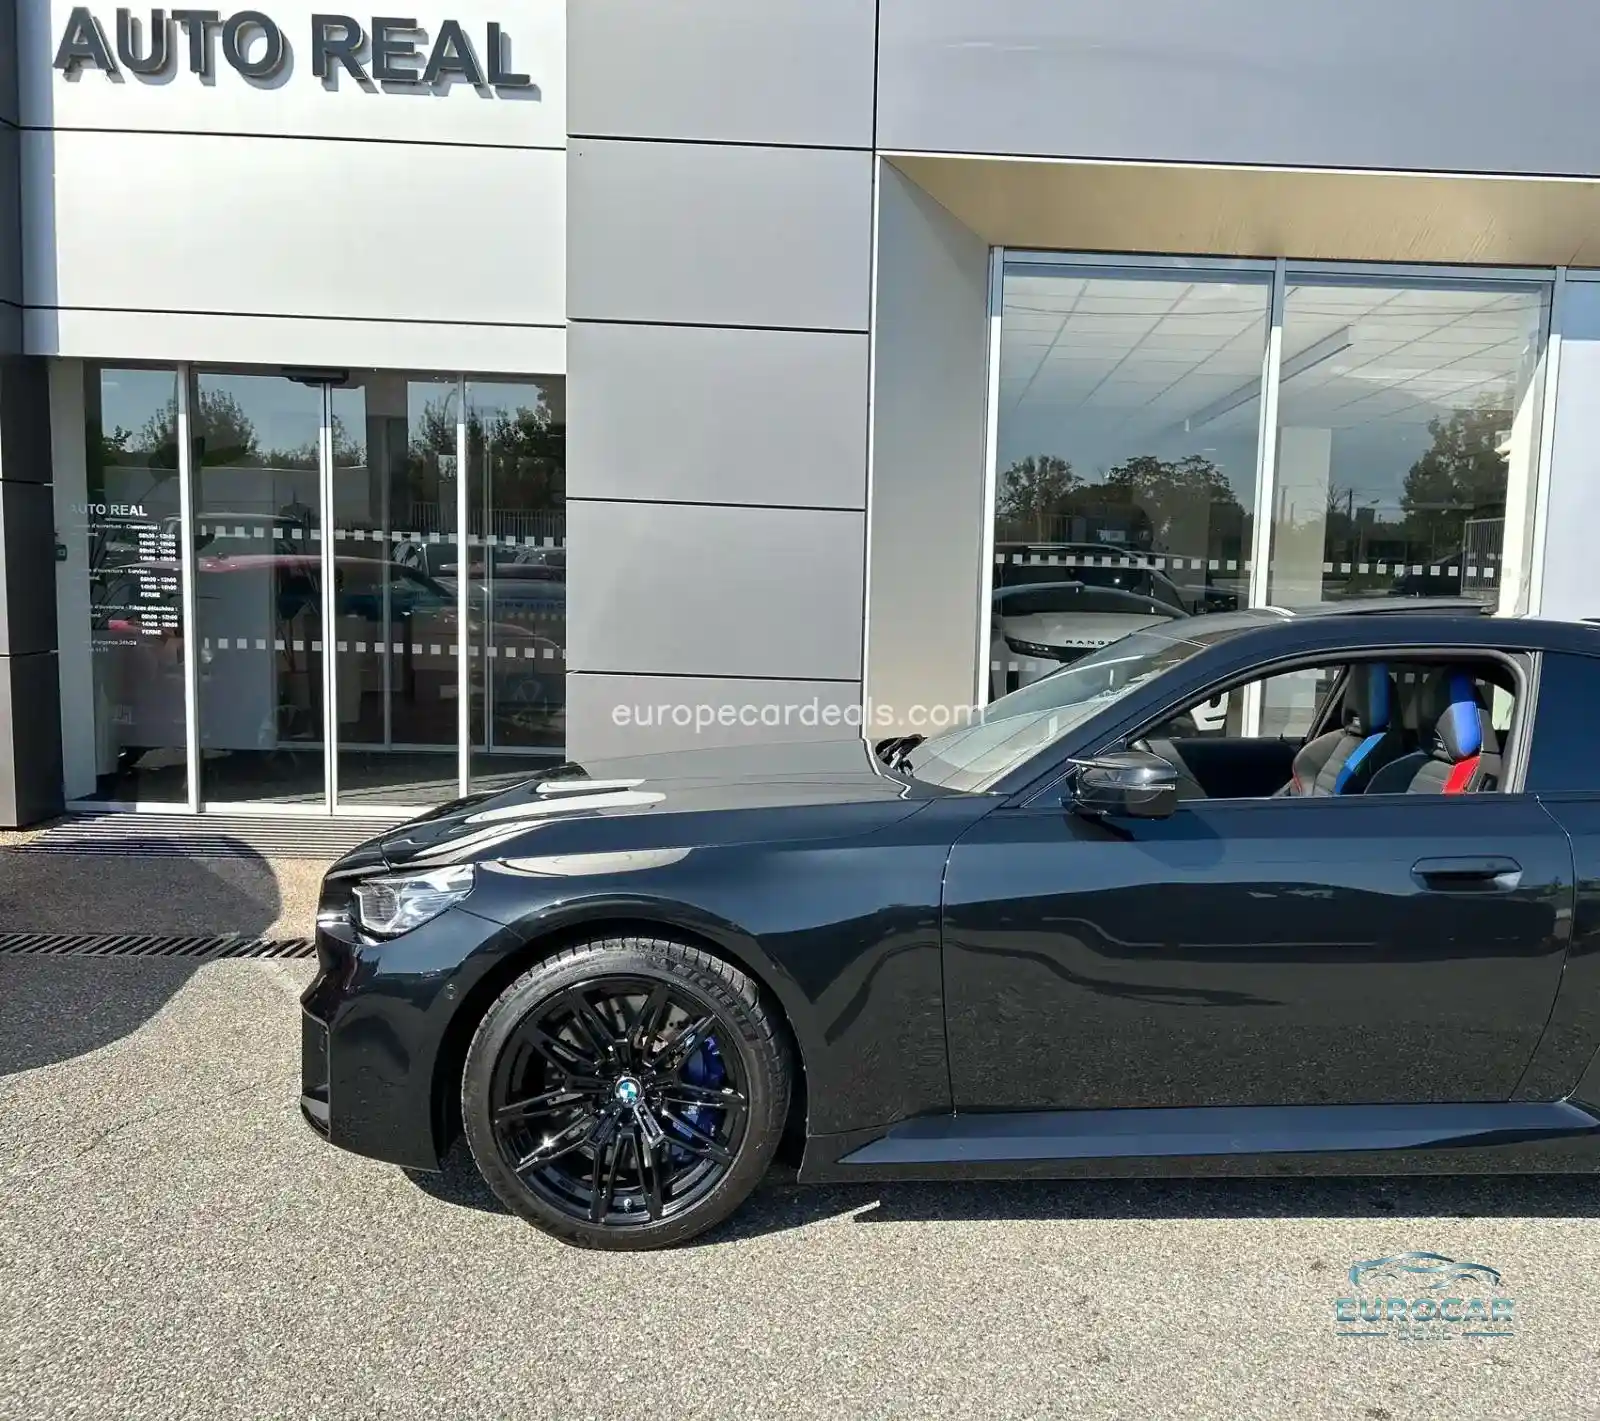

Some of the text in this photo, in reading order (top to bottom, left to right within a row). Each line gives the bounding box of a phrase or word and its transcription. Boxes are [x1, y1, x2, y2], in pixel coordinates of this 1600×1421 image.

[53, 6, 533, 88] AUTO REAL
[110, 504, 148, 517] REAL
